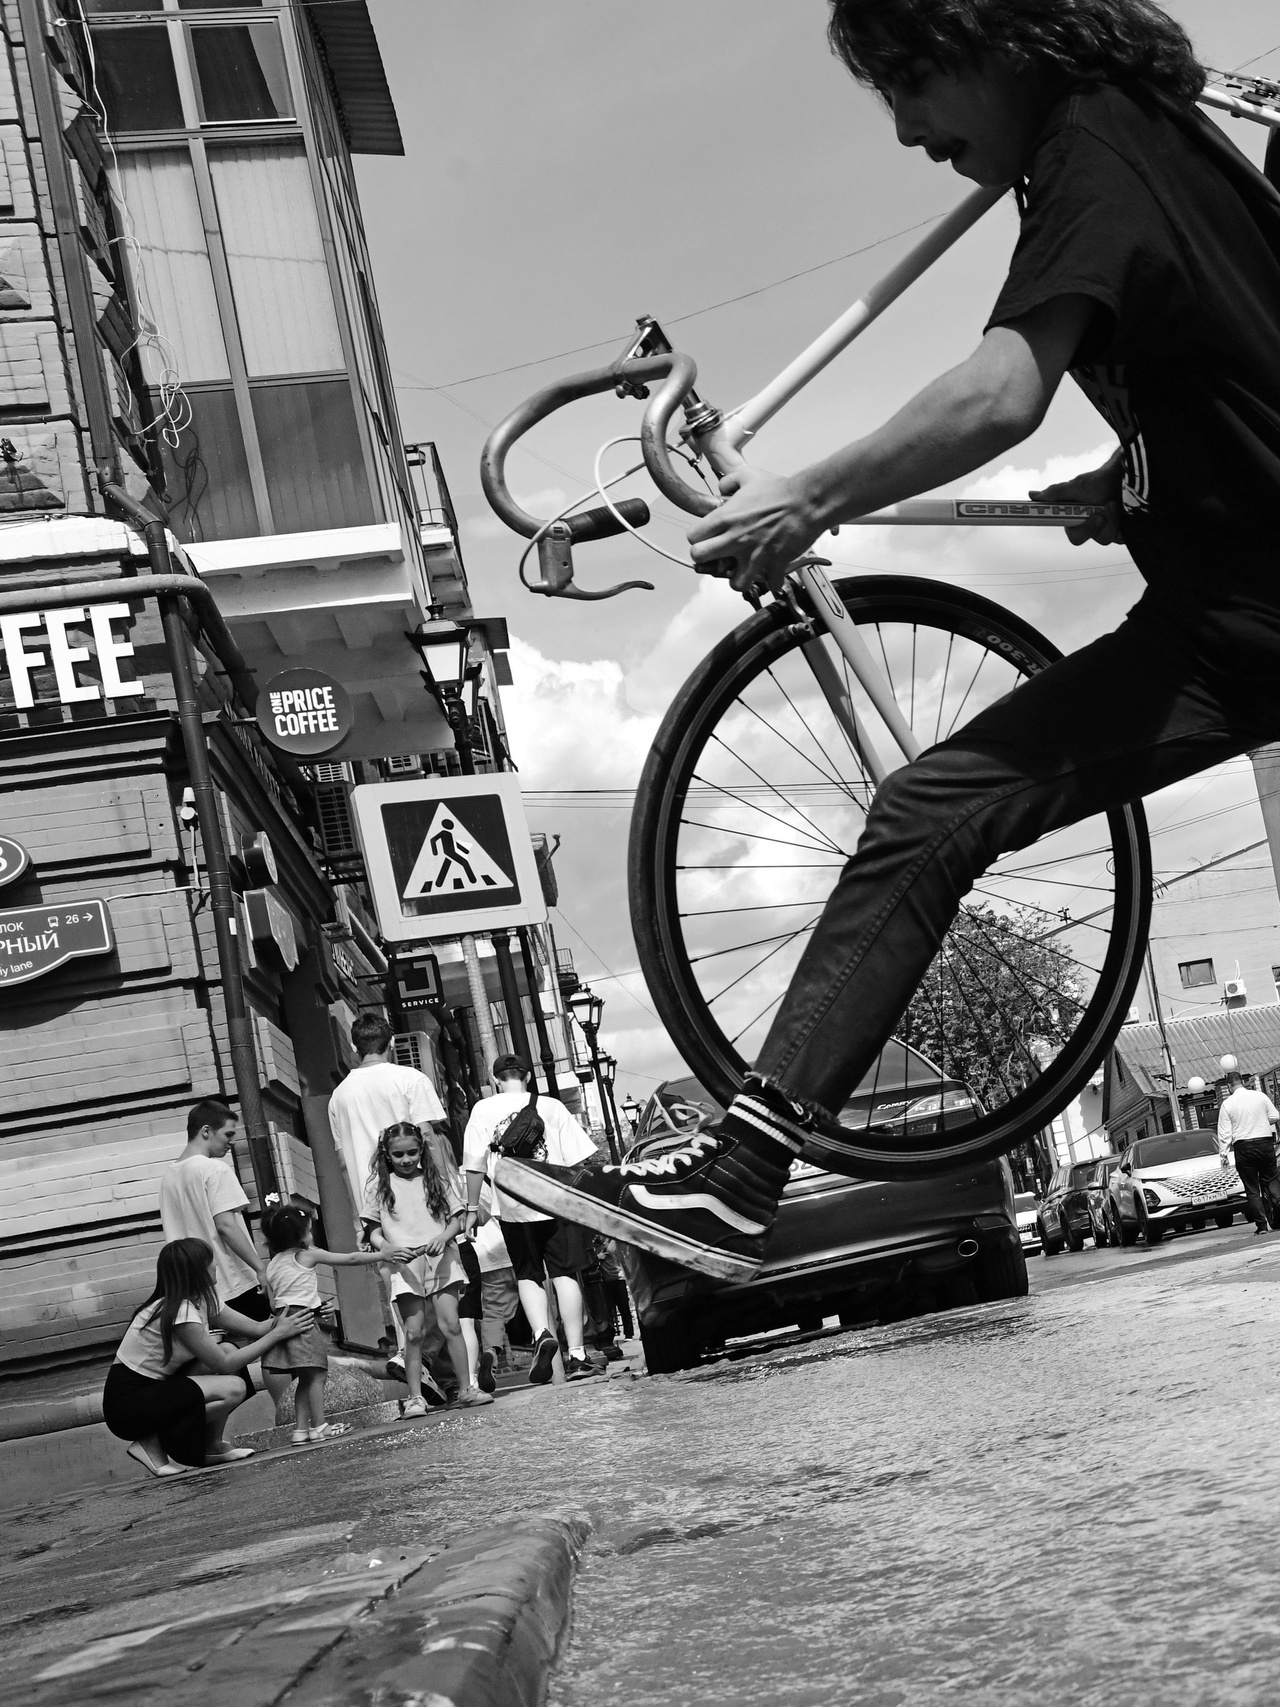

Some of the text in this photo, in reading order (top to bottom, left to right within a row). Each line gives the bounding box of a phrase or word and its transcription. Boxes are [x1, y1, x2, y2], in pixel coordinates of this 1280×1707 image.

[965, 504, 1104, 515] СПУТНИ
[0, 603, 145, 709] FEE
[269, 686, 335, 714] ONE PRICE
[274, 709, 339, 737] COFFEE
[65, 914, 80, 925] 26
[10, 960, 33, 973] lane
[401, 997, 440, 1008] SERVICE
